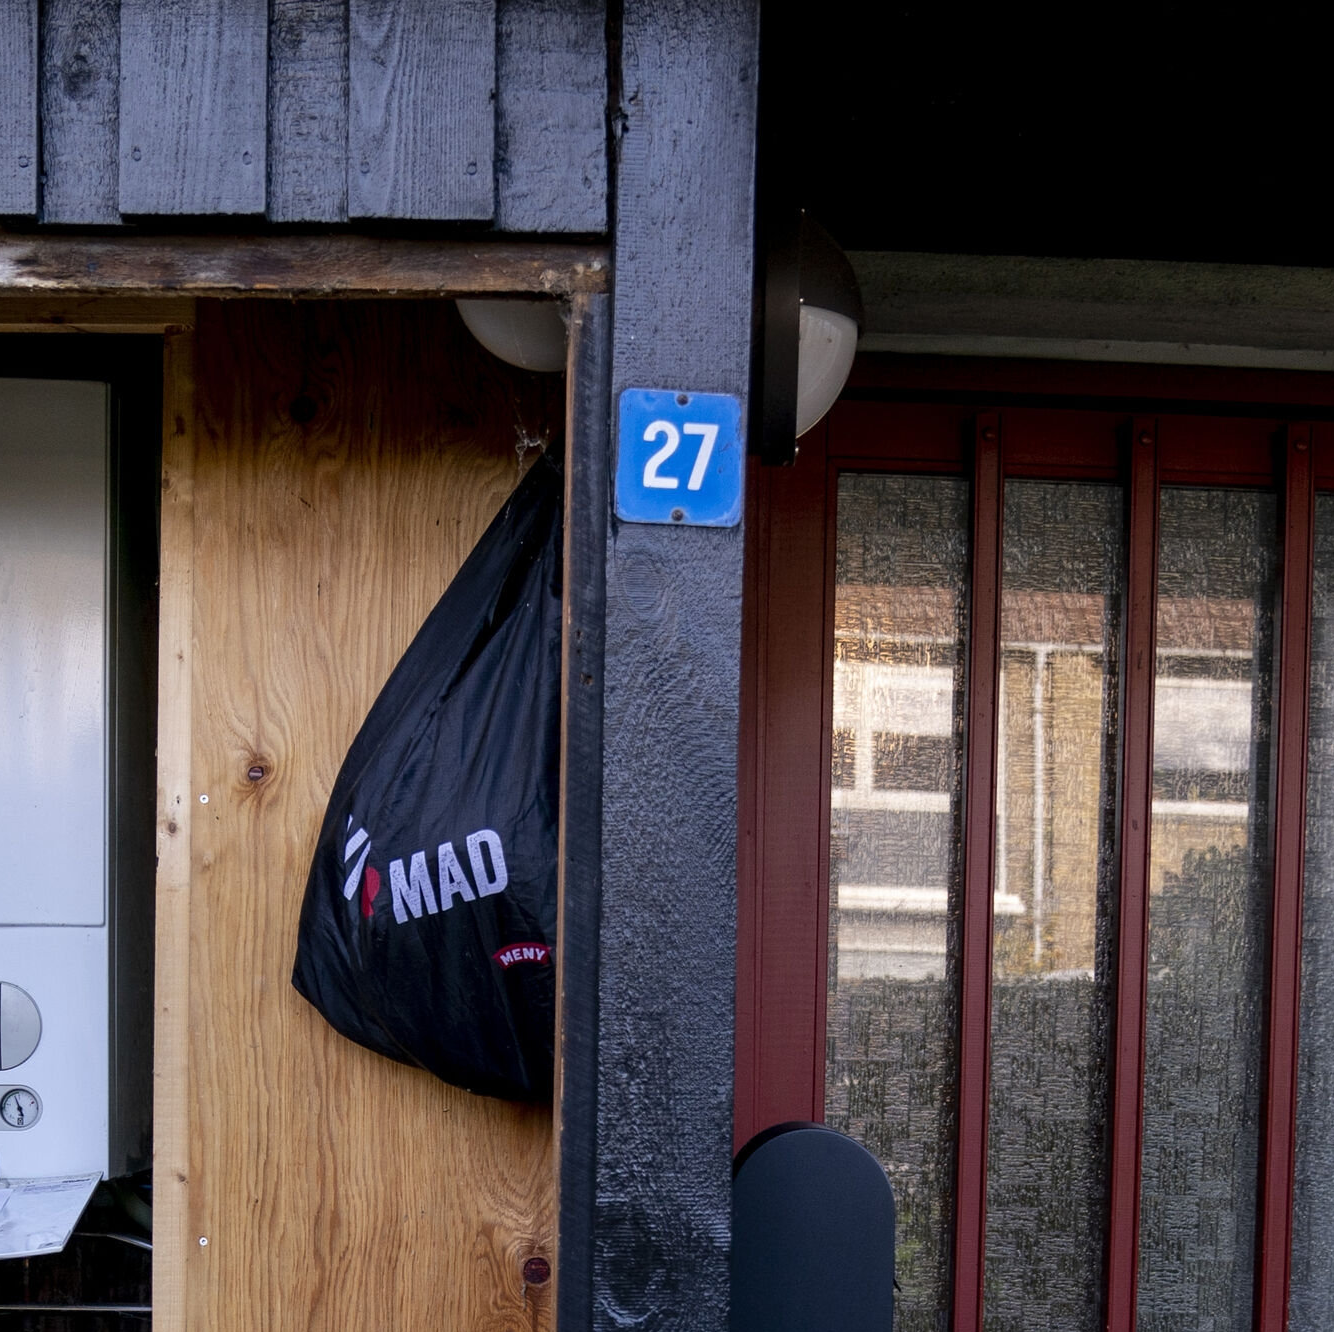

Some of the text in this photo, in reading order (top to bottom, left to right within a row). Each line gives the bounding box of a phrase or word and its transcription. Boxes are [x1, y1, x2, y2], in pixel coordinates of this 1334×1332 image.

[643, 419, 719, 491] 27
[388, 828, 509, 925] MAD
[499, 946, 546, 967] MENY
